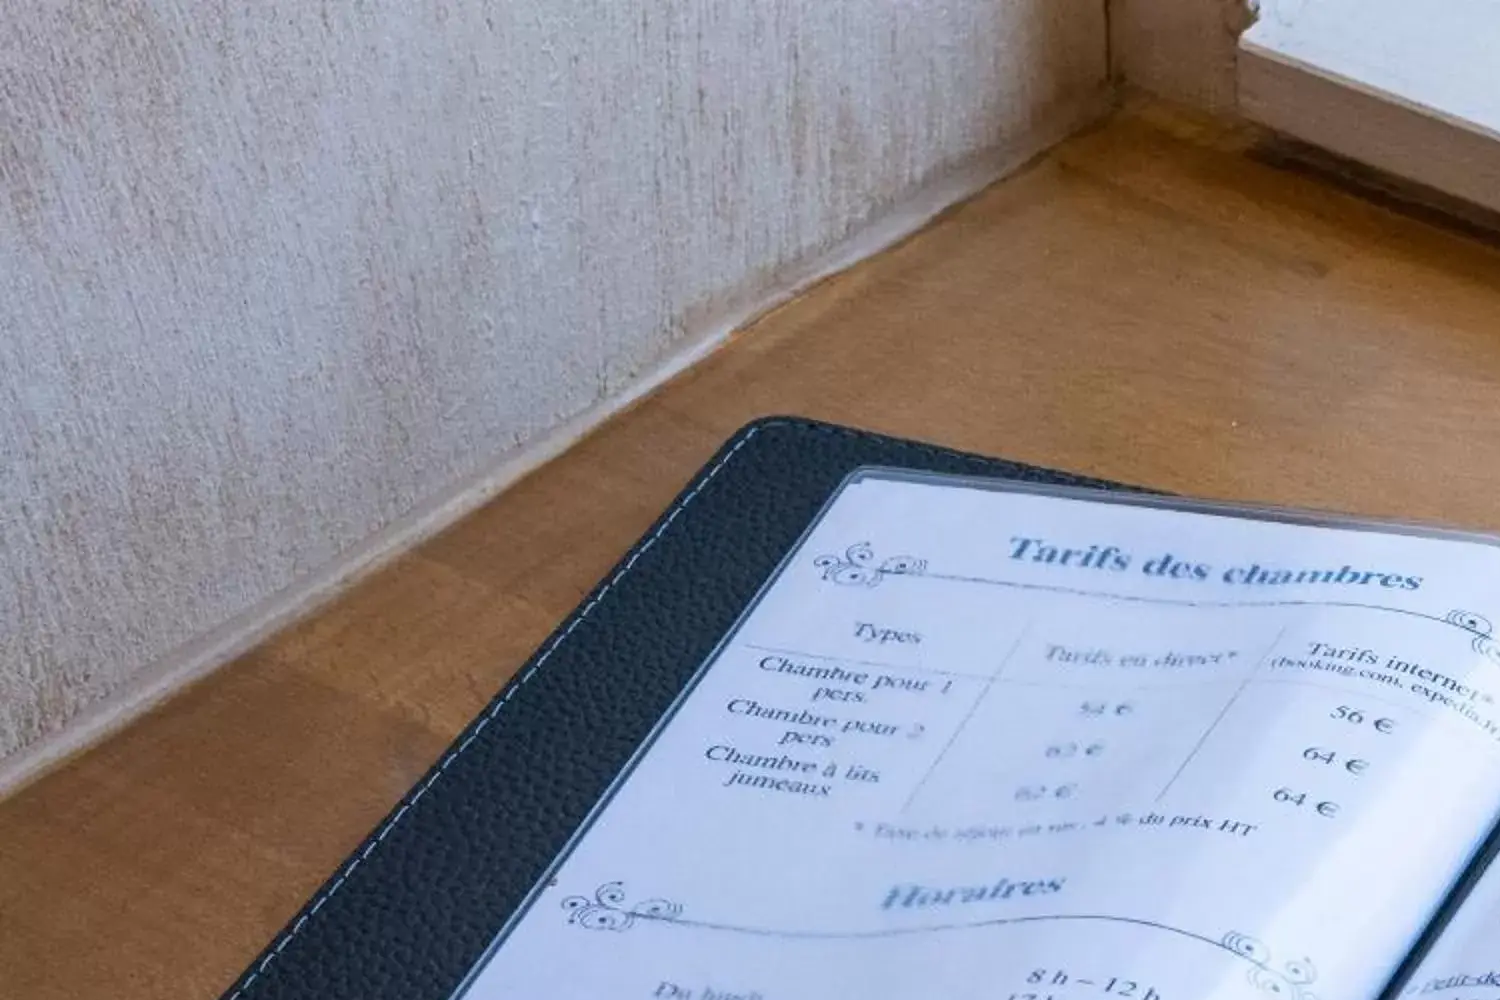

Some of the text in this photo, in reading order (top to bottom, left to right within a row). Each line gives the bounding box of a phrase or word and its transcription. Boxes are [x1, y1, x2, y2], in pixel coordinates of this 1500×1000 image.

[1008, 535, 1424, 592] Tarifs des chambres
[854, 620, 923, 645] Types
[1046, 643, 1112, 666] Tarifs
[1119, 653, 1147, 669] en
[1308, 640, 1380, 666] Tarifs
[758, 654, 953, 696] Chambre pour 1
[811, 685, 869, 704] pers.
[726, 697, 838, 729] Chambre
[841, 718, 899, 738] pour
[1329, 705, 1397, 735] 56 €
[704, 744, 881, 784] Chambre à lits
[1302, 746, 1371, 776] 64 €
[721, 768, 833, 797] jumeaux
[1273, 786, 1342, 818] 64 €
[1138, 811, 1166, 827] du
[1168, 813, 1215, 831] prix
[1218, 816, 1260, 837] HT
[880, 876, 1068, 912] Horaires
[1026, 968, 1047, 985] 8
[1051, 969, 1069, 988] h
[1103, 976, 1138, 998] 12
